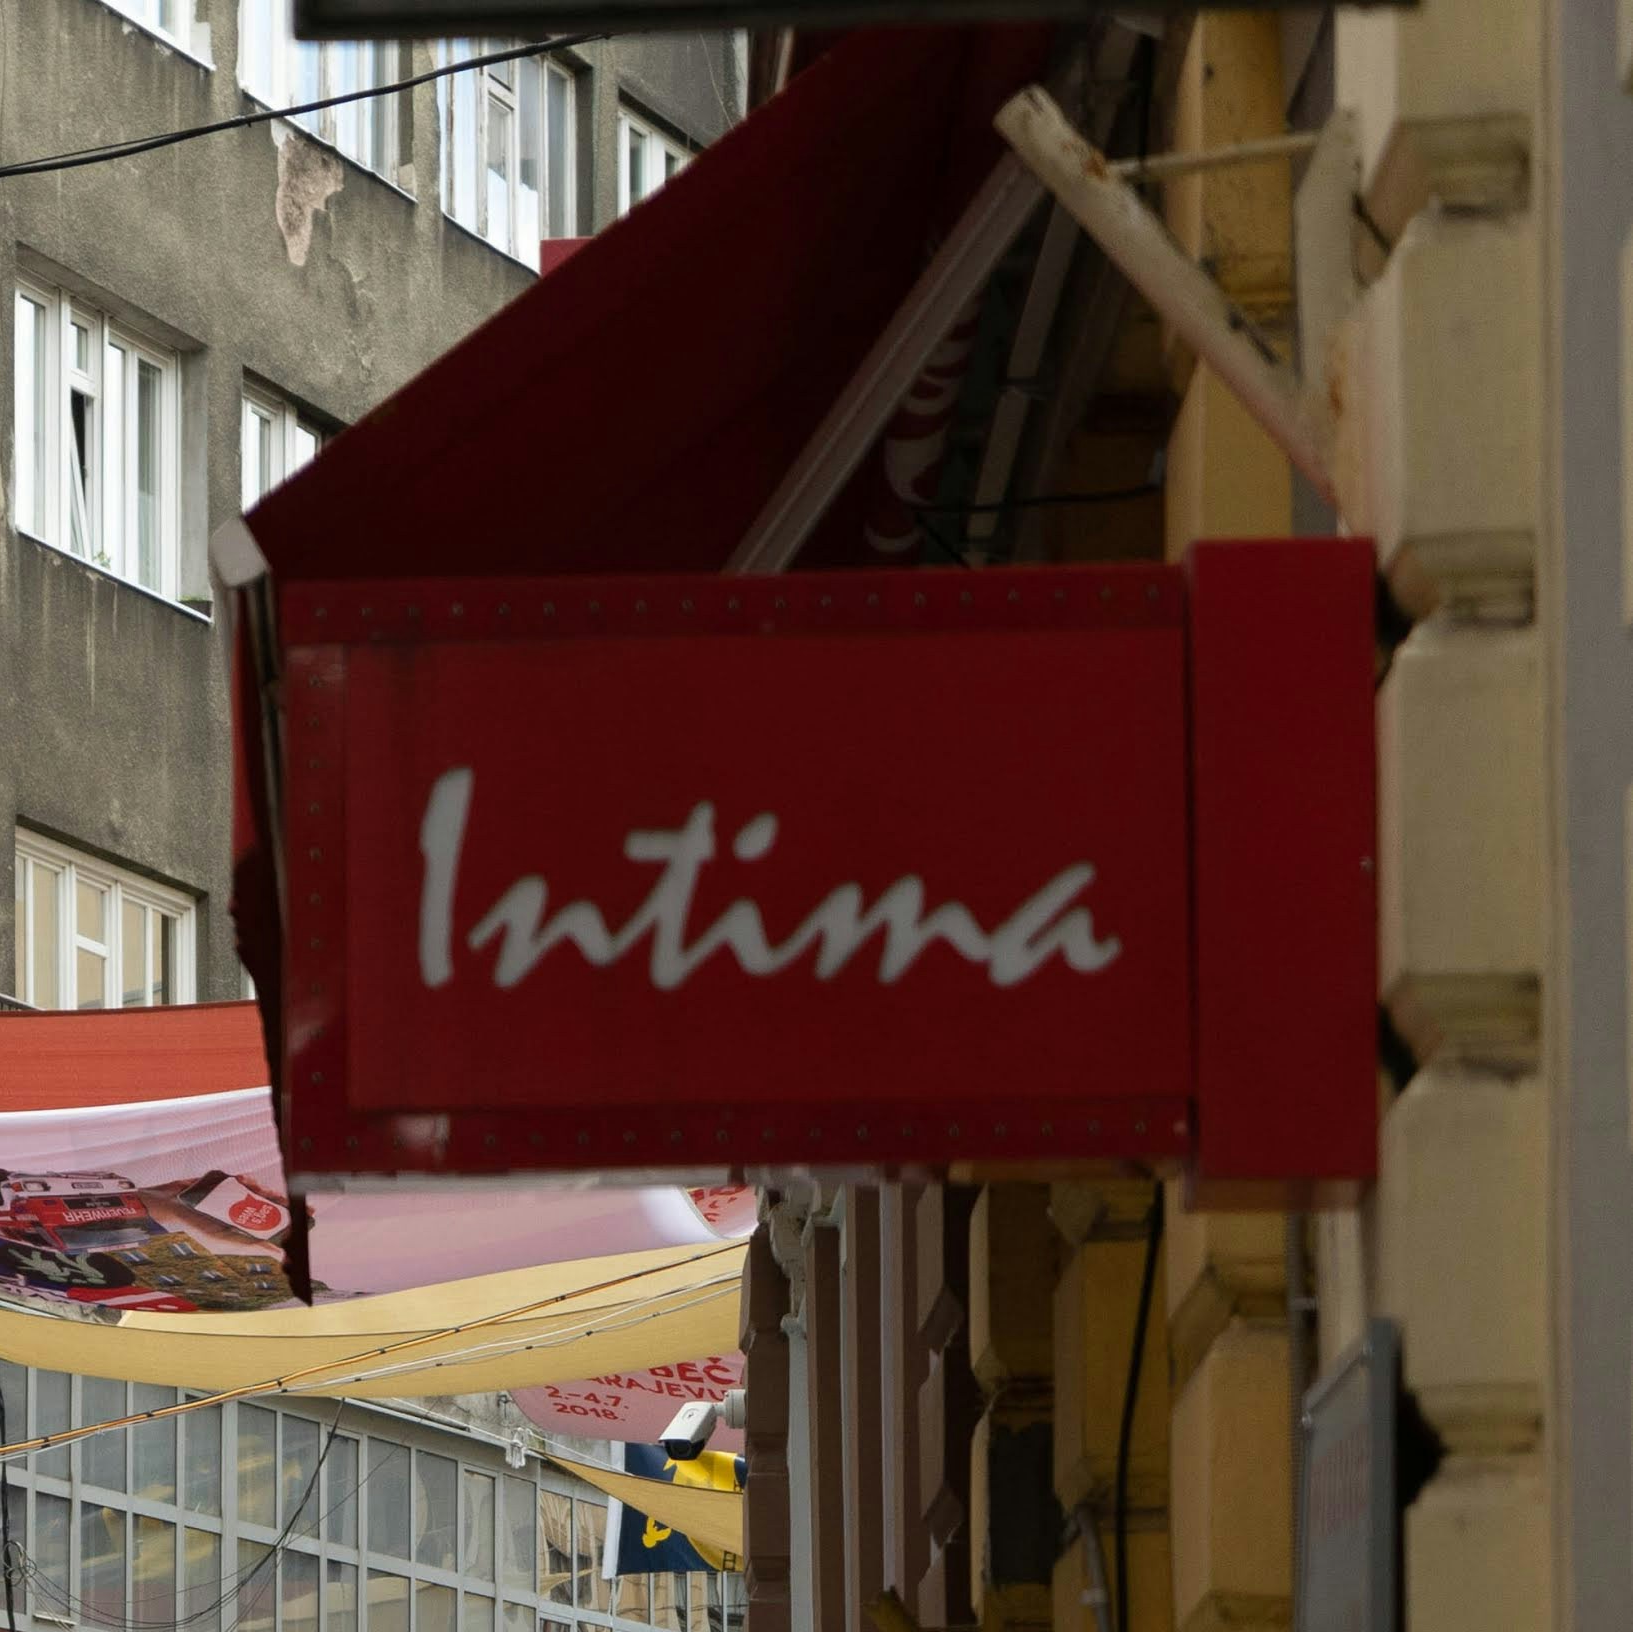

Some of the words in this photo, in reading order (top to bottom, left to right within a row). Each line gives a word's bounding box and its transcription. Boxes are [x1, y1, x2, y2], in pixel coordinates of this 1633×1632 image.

[418, 766, 1122, 990] Intima
[648, 1356, 745, 1386] BEČ
[552, 1402, 626, 1422] 2018.
